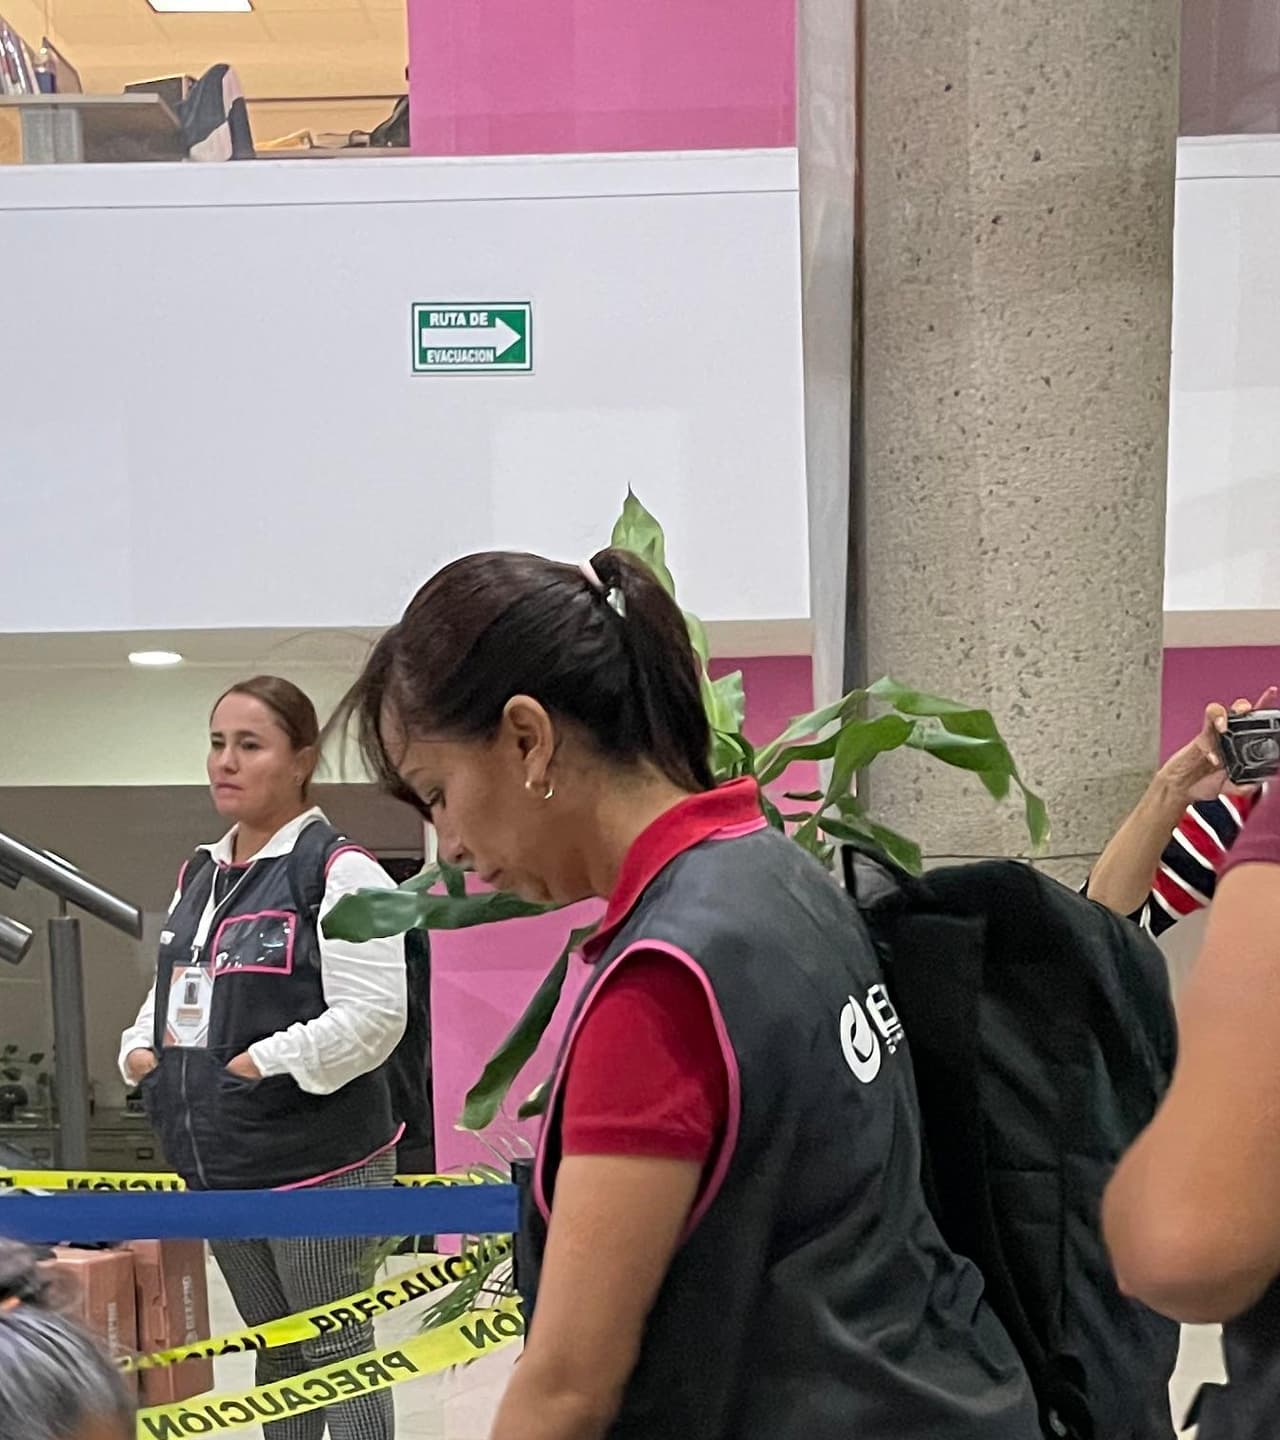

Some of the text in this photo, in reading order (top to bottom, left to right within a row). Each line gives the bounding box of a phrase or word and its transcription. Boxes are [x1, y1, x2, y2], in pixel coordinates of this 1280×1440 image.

[429, 312, 489, 327] RUTA DE
[426, 349, 495, 363] EVACUACION
